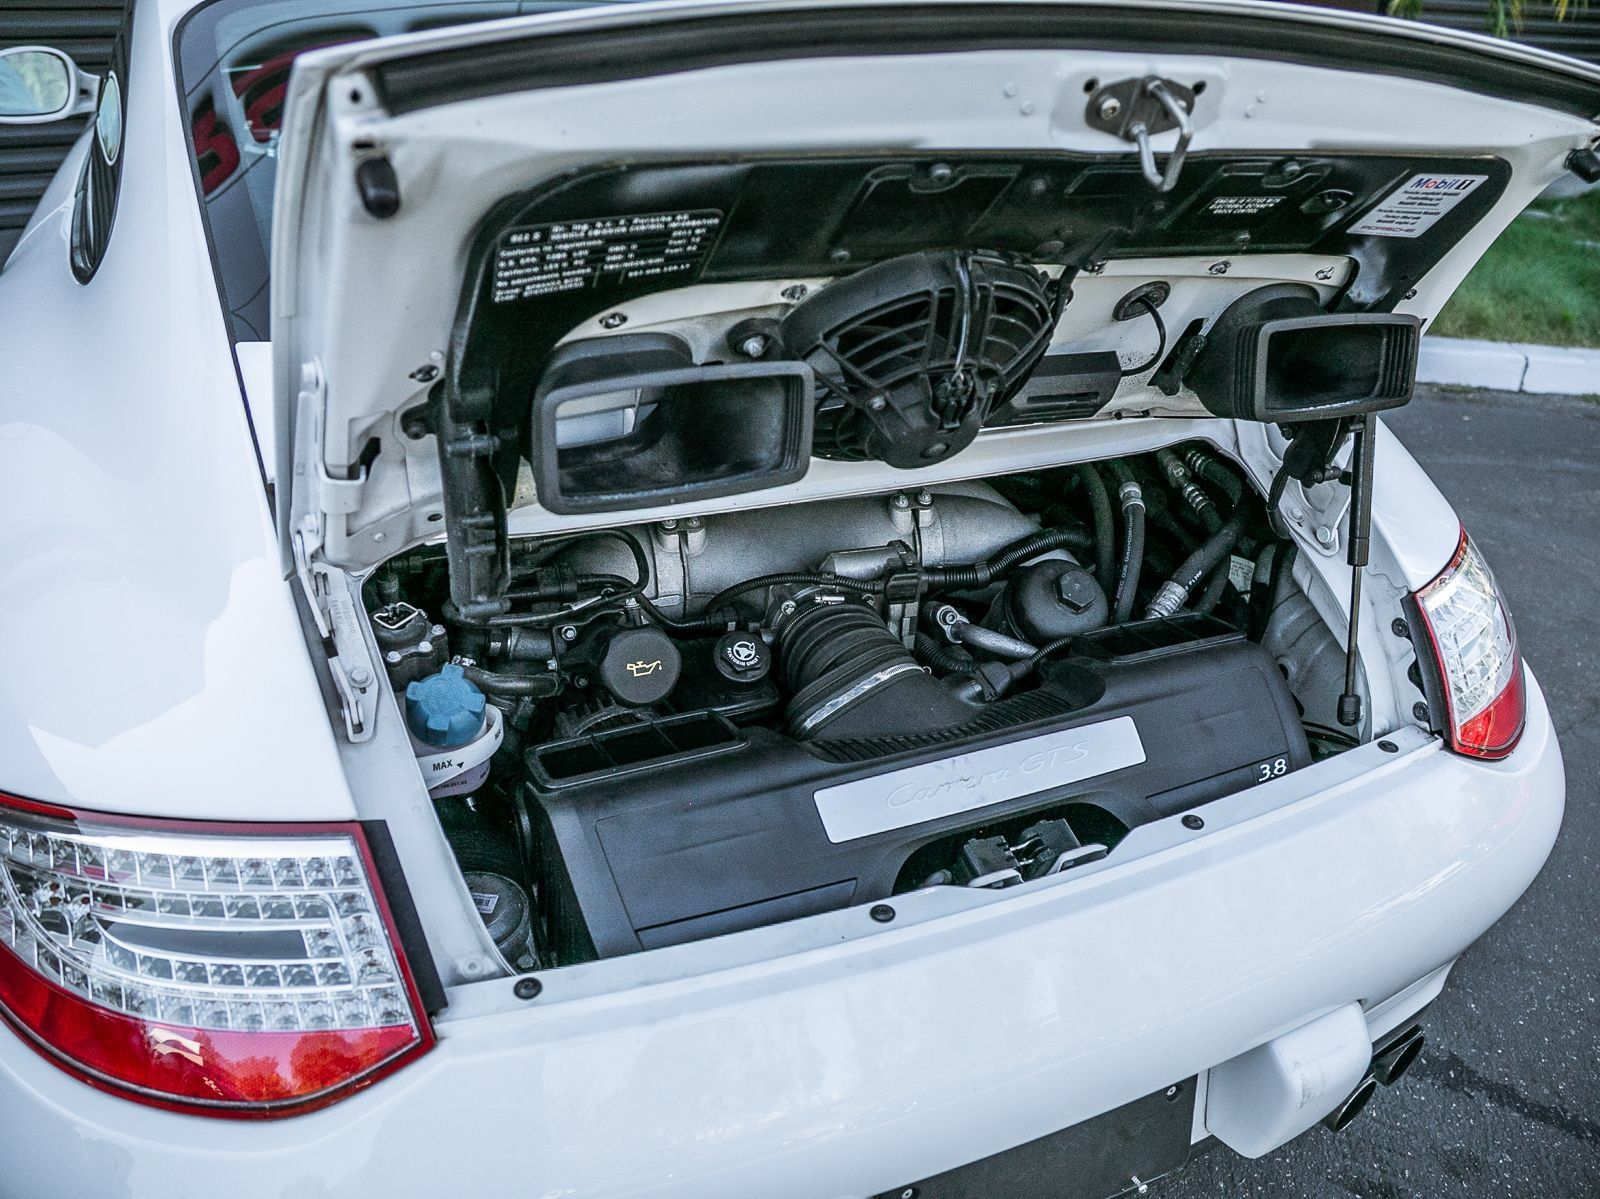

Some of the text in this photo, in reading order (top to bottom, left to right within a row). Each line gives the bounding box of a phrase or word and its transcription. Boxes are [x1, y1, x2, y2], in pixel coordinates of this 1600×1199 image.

[1411, 177, 1460, 190] Mobil
[1360, 225, 1416, 233] PORSCHE
[727, 647, 746, 666] PENTOSIN
[432, 759, 453, 772] MAX
[1258, 758, 1287, 781] 3.8
[886, 740, 1090, 809] Carrera GTS
